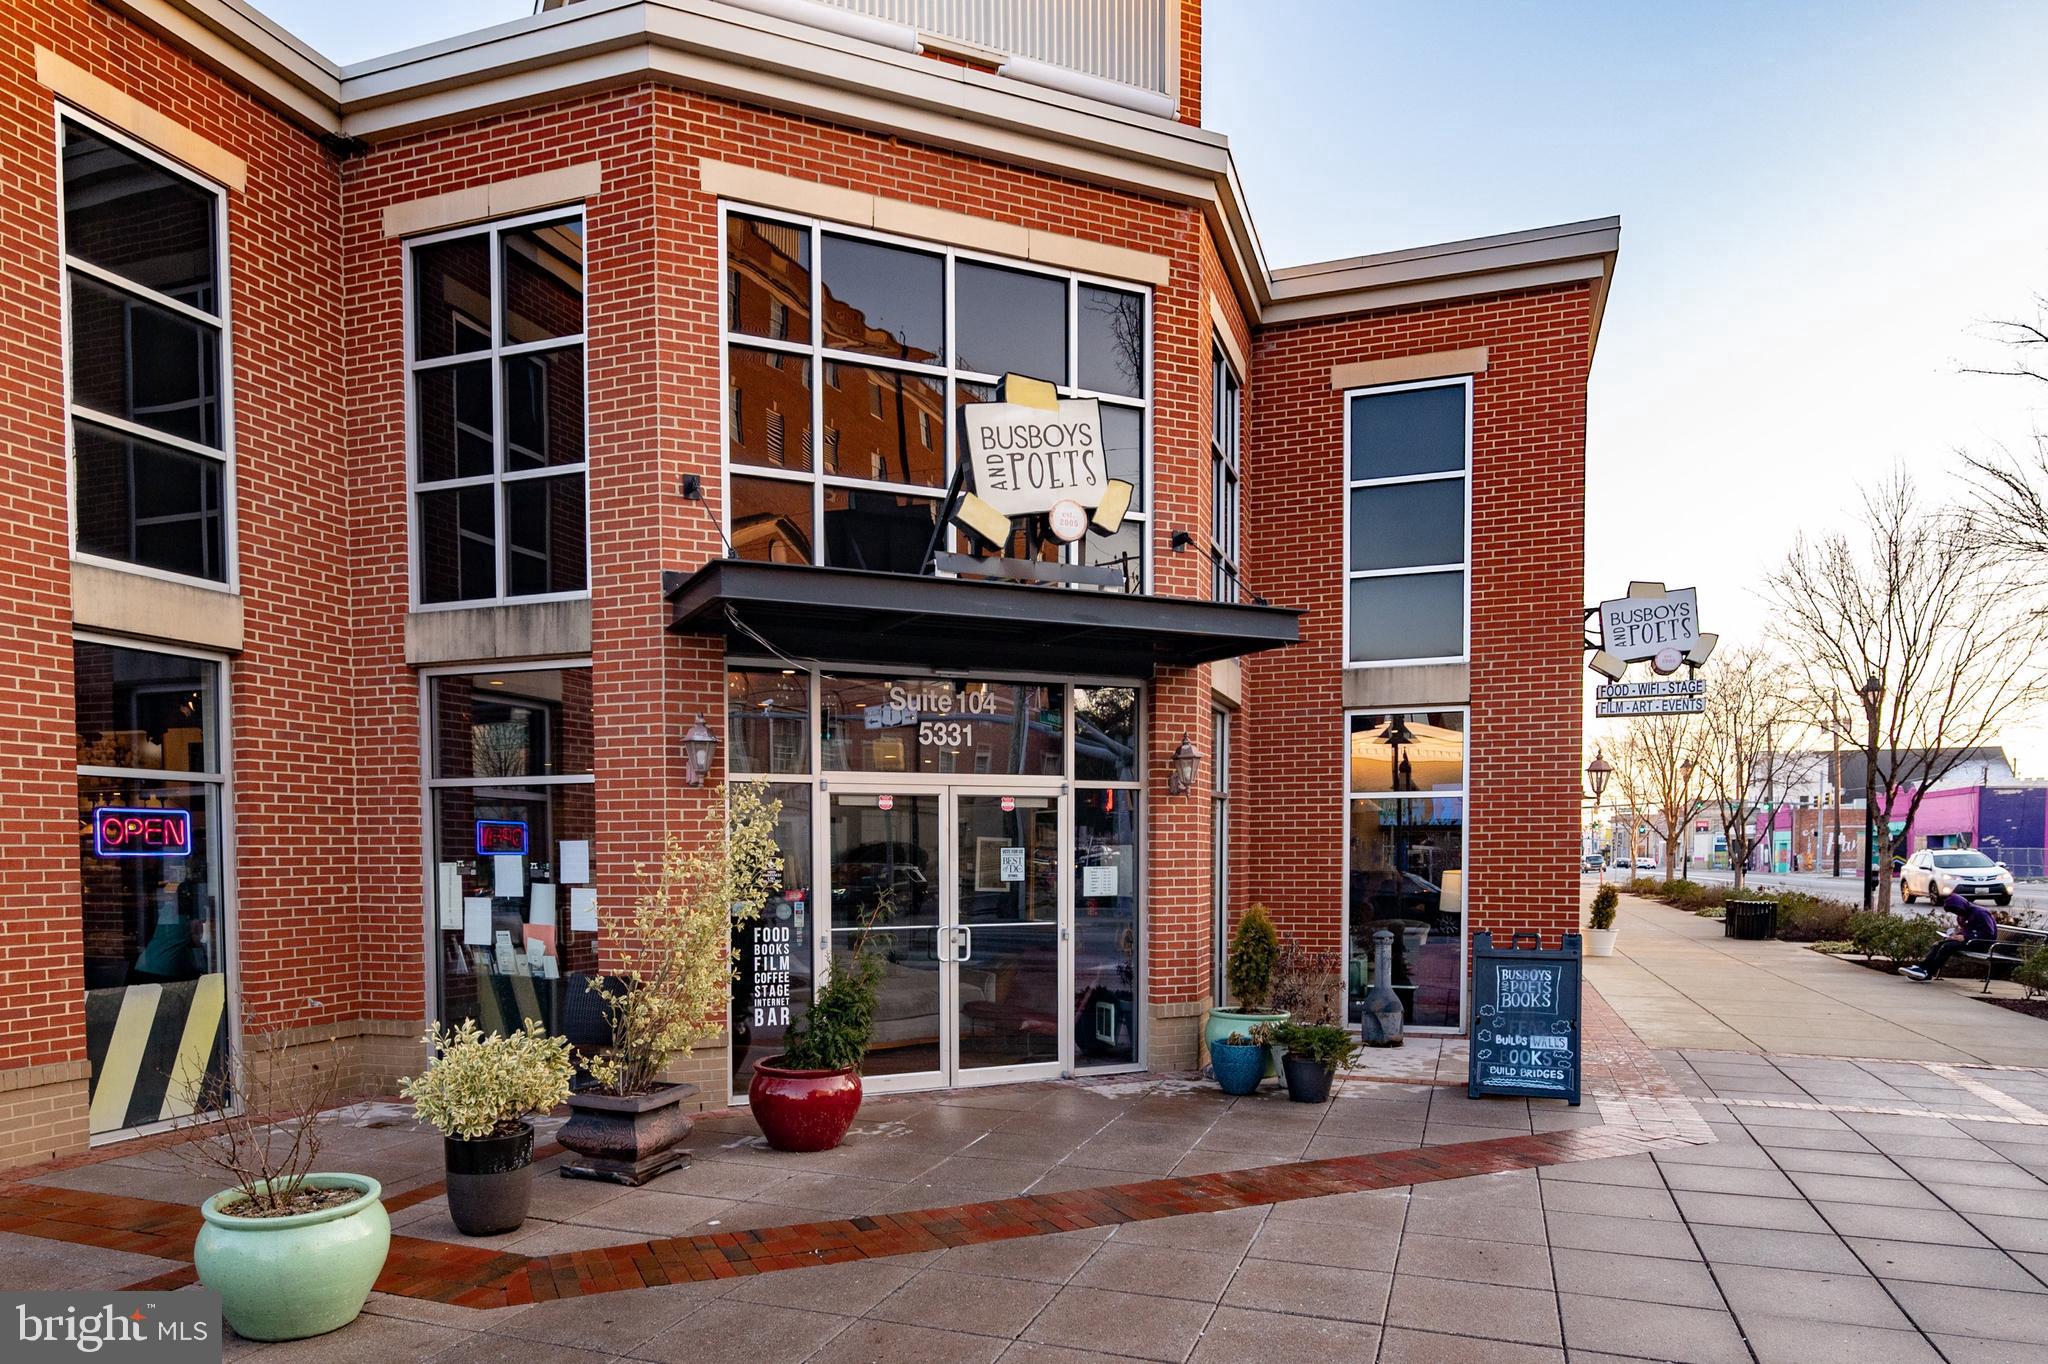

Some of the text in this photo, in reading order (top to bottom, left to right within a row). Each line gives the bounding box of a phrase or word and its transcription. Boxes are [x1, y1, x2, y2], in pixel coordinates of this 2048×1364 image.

[980, 422, 1093, 450] BUSBOYS
[986, 453, 1009, 492] AND
[1006, 450, 1097, 491] POETS
[1610, 602, 1690, 626] BUSBOYS
[1613, 626, 1627, 647] AND
[1627, 617, 1692, 646] POETS
[1600, 681, 1702, 697] FOOD WIFI STAGE
[889, 687, 997, 714] Suite 104
[1600, 698, 1703, 713] FILM ART EVENTS
[918, 721, 973, 747] 5331
[102, 817, 185, 845] OPEN
[1002, 857, 1023, 865] BEST
[754, 927, 790, 943] FOOD
[754, 943, 790, 956] BOOKS
[754, 956, 790, 972] FILM
[754, 972, 790, 984] COFFEE
[1501, 969, 1552, 981] BUSBOYS
[754, 984, 790, 998] STAGE
[1510, 980, 1552, 994] POETS
[754, 998, 790, 1007] INTERNET
[1500, 993, 1551, 1008] BOOKS
[754, 1007, 790, 1027] BAR
[1533, 1036, 1566, 1049] WALLS
[1500, 1049, 1553, 1067] BOOKS
[1490, 1065, 1565, 1080] BUILD BRIDGES
